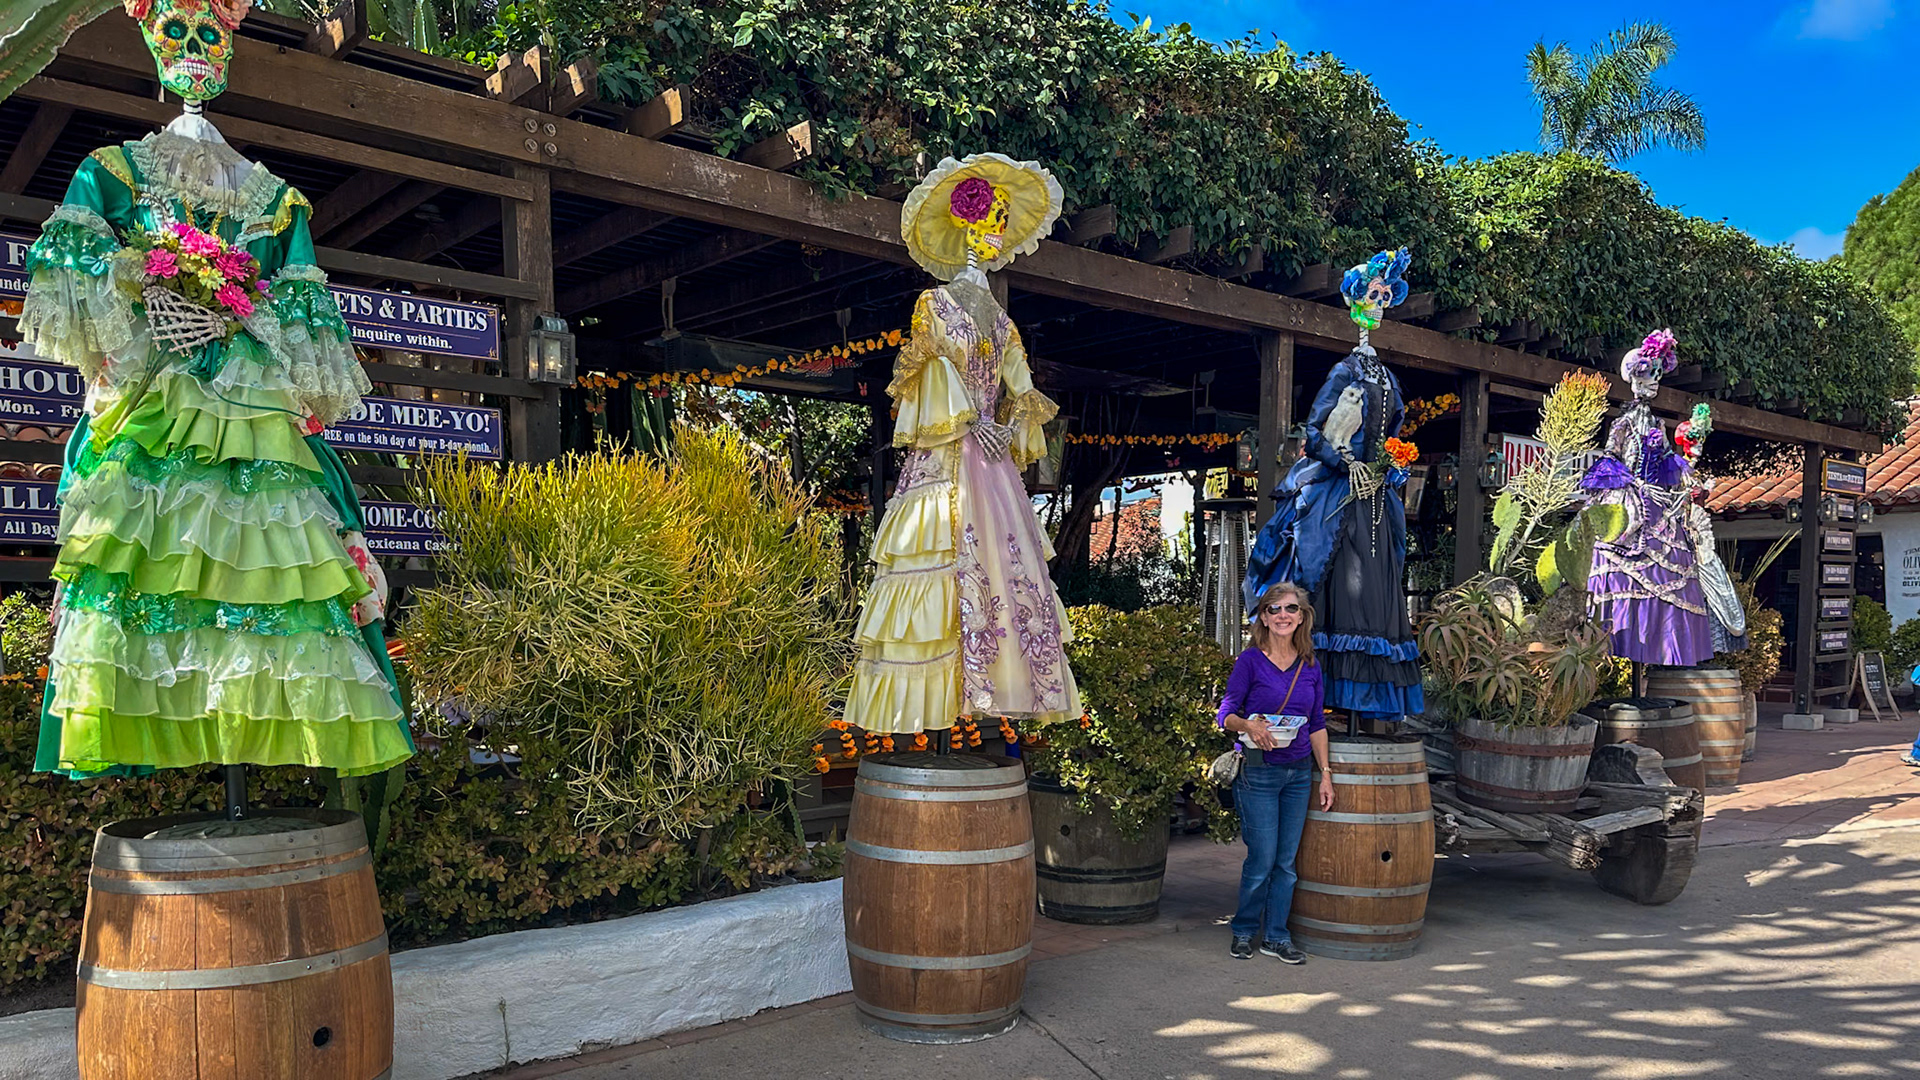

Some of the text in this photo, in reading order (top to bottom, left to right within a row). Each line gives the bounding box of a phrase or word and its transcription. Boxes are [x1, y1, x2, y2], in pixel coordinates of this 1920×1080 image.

[330, 290, 488, 332] ETS & PARTIES
[352, 325, 453, 349] inquire within.
[0, 366, 87, 396] HOU
[0, 399, 41, 415] Mon.
[60, 404, 83, 418] Fr
[390, 404, 490, 434] MEE-YO!
[322, 429, 342, 442] REE
[344, 432, 356, 443] on
[357, 431, 372, 444] the
[374, 432, 388, 446] 5th
[390, 434, 406, 449] day
[407, 436, 417, 448] of
[4, 521, 59, 538] All Day
[365, 537, 420, 550] exicana
